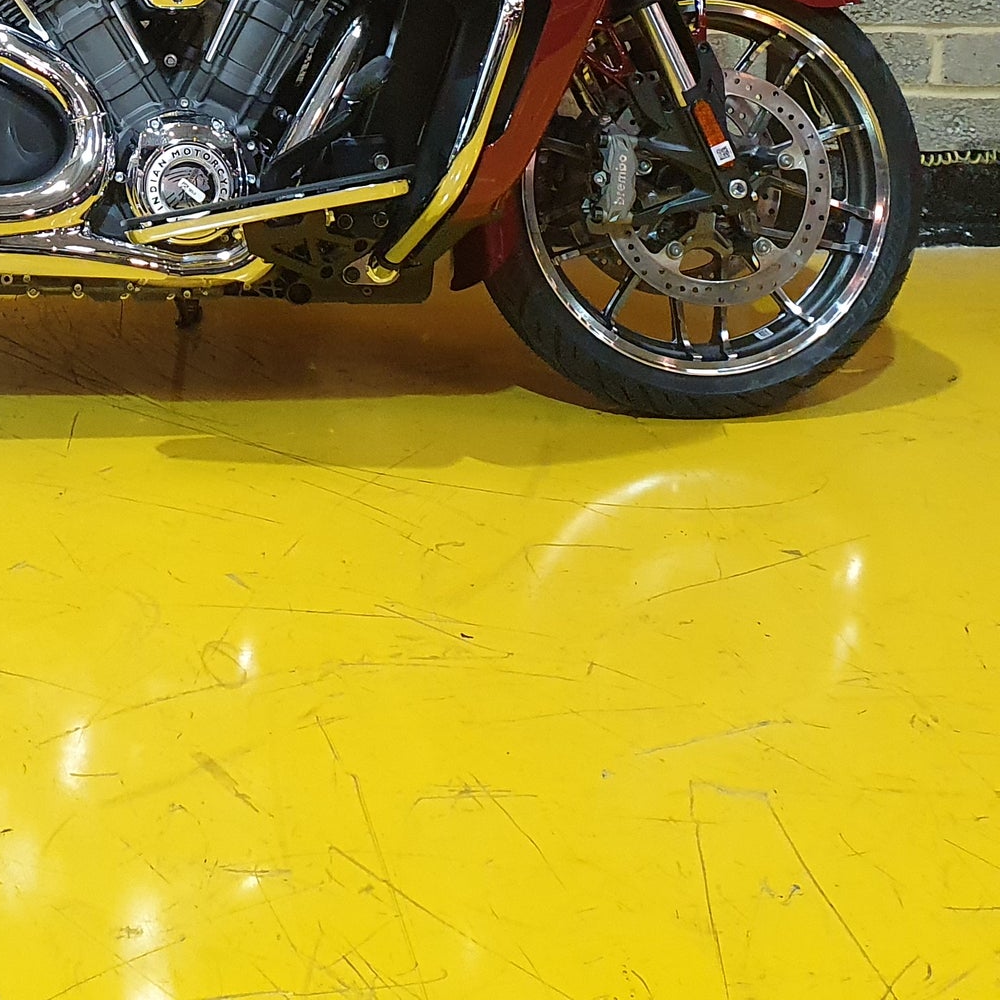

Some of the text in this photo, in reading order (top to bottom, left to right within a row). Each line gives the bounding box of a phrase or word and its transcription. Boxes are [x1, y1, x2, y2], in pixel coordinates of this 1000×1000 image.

[149, 159, 167, 212] INDIAN
[171, 148, 229, 202] MOTORCYCL
[613, 154, 628, 206] brembo
